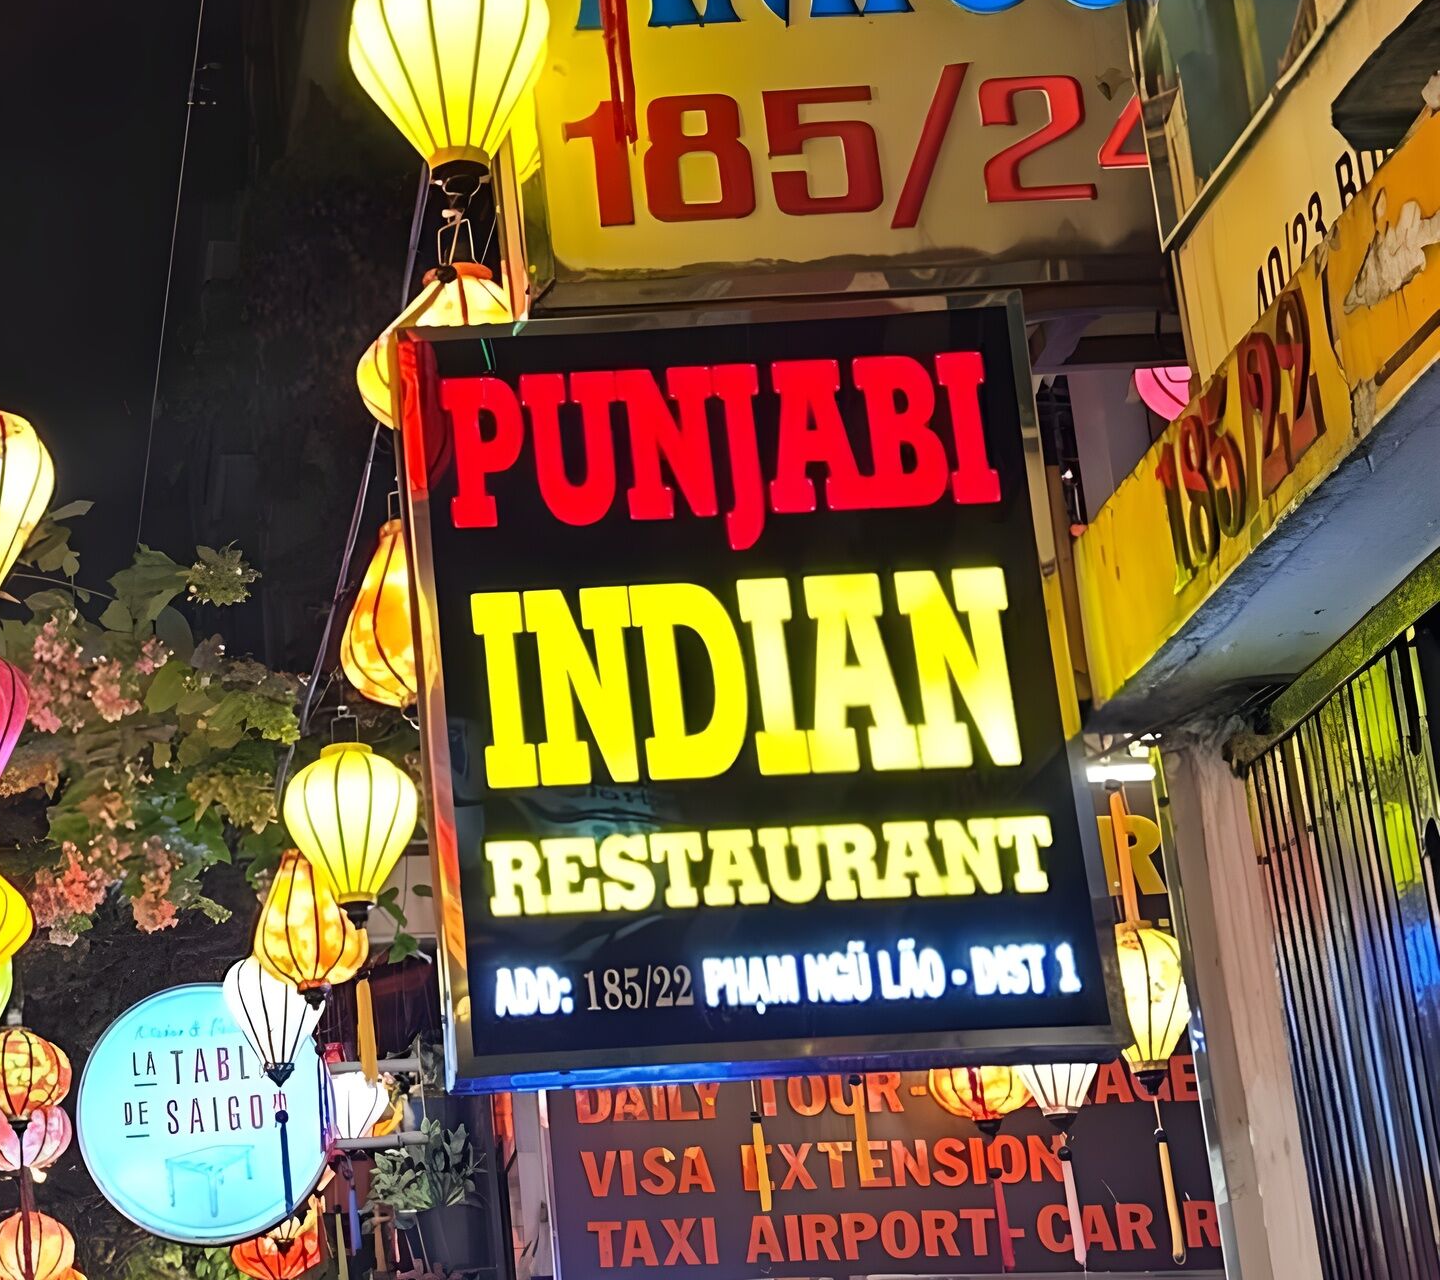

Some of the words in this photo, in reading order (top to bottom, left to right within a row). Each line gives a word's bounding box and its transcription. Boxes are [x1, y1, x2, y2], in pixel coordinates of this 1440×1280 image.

[440, 350, 1002, 550] PUNJABI
[470, 565, 1023, 789] INDIAN
[485, 814, 1054, 917] RESTAURANT
[494, 966, 575, 1018] ADD:
[584, 964, 695, 1012] 185/22
[969, 943, 1047, 996] DIST
[1055, 942, 1082, 994] 1
[132, 1050, 157, 1077] LA
[170, 1046, 268, 1085] TABL
[124, 1100, 149, 1127] DE
[574, 1082, 721, 1124] DAILY
[580, 1145, 717, 1198] VISA
[740, 1133, 1065, 1193] EXTENSION
[586, 1216, 720, 1268] TAXI
[1036, 1202, 1157, 1253] CAR
